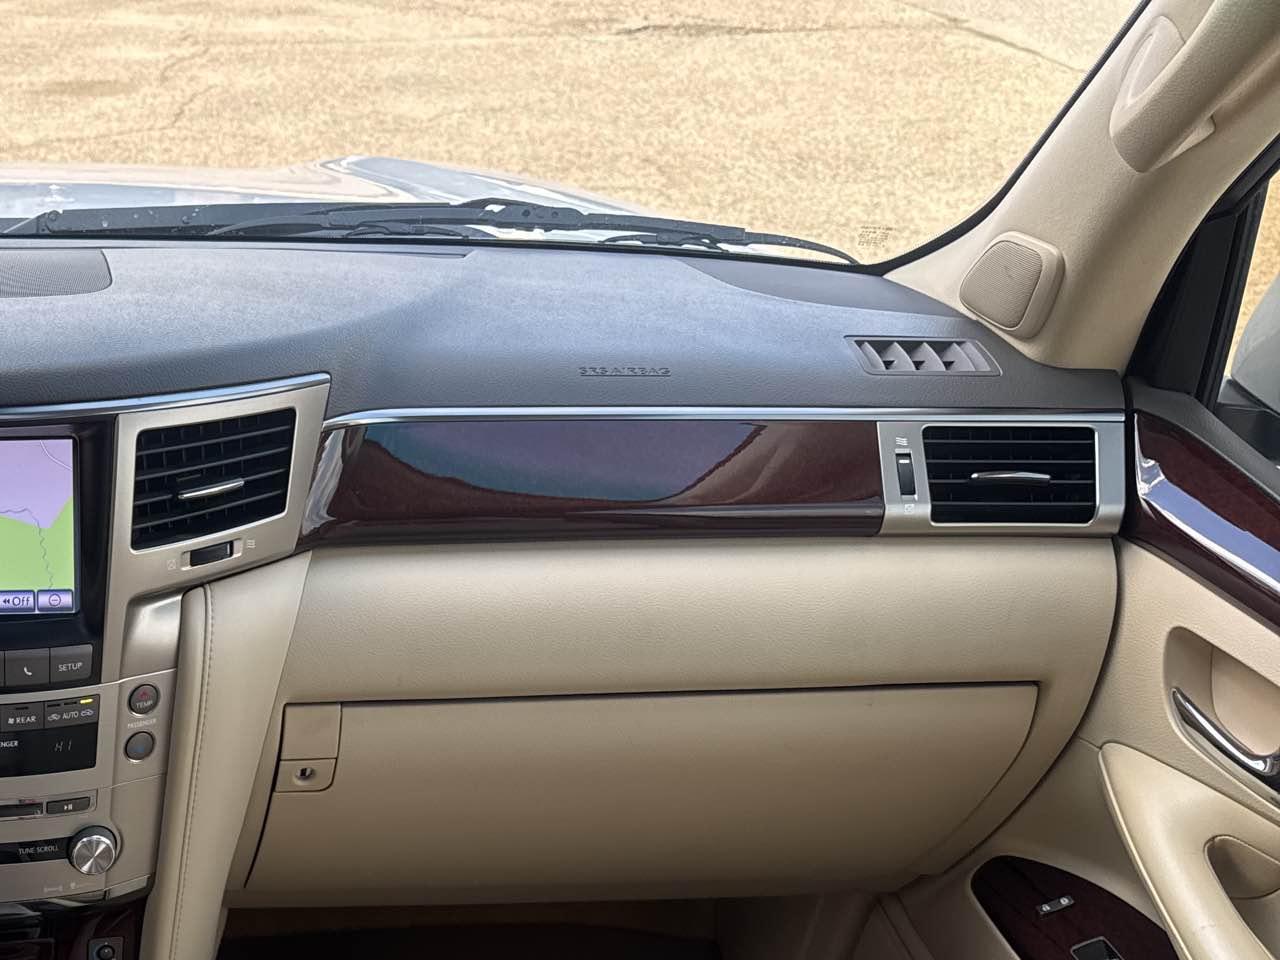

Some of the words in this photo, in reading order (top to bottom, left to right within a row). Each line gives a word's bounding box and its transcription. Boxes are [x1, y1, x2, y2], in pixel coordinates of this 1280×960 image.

[611, 367, 671, 375] AIRBAG
[11, 596, 30, 607] Off
[58, 662, 83, 672] SETUP
[62, 710, 79, 719] AUTO
[15, 715, 37, 724] REAR
